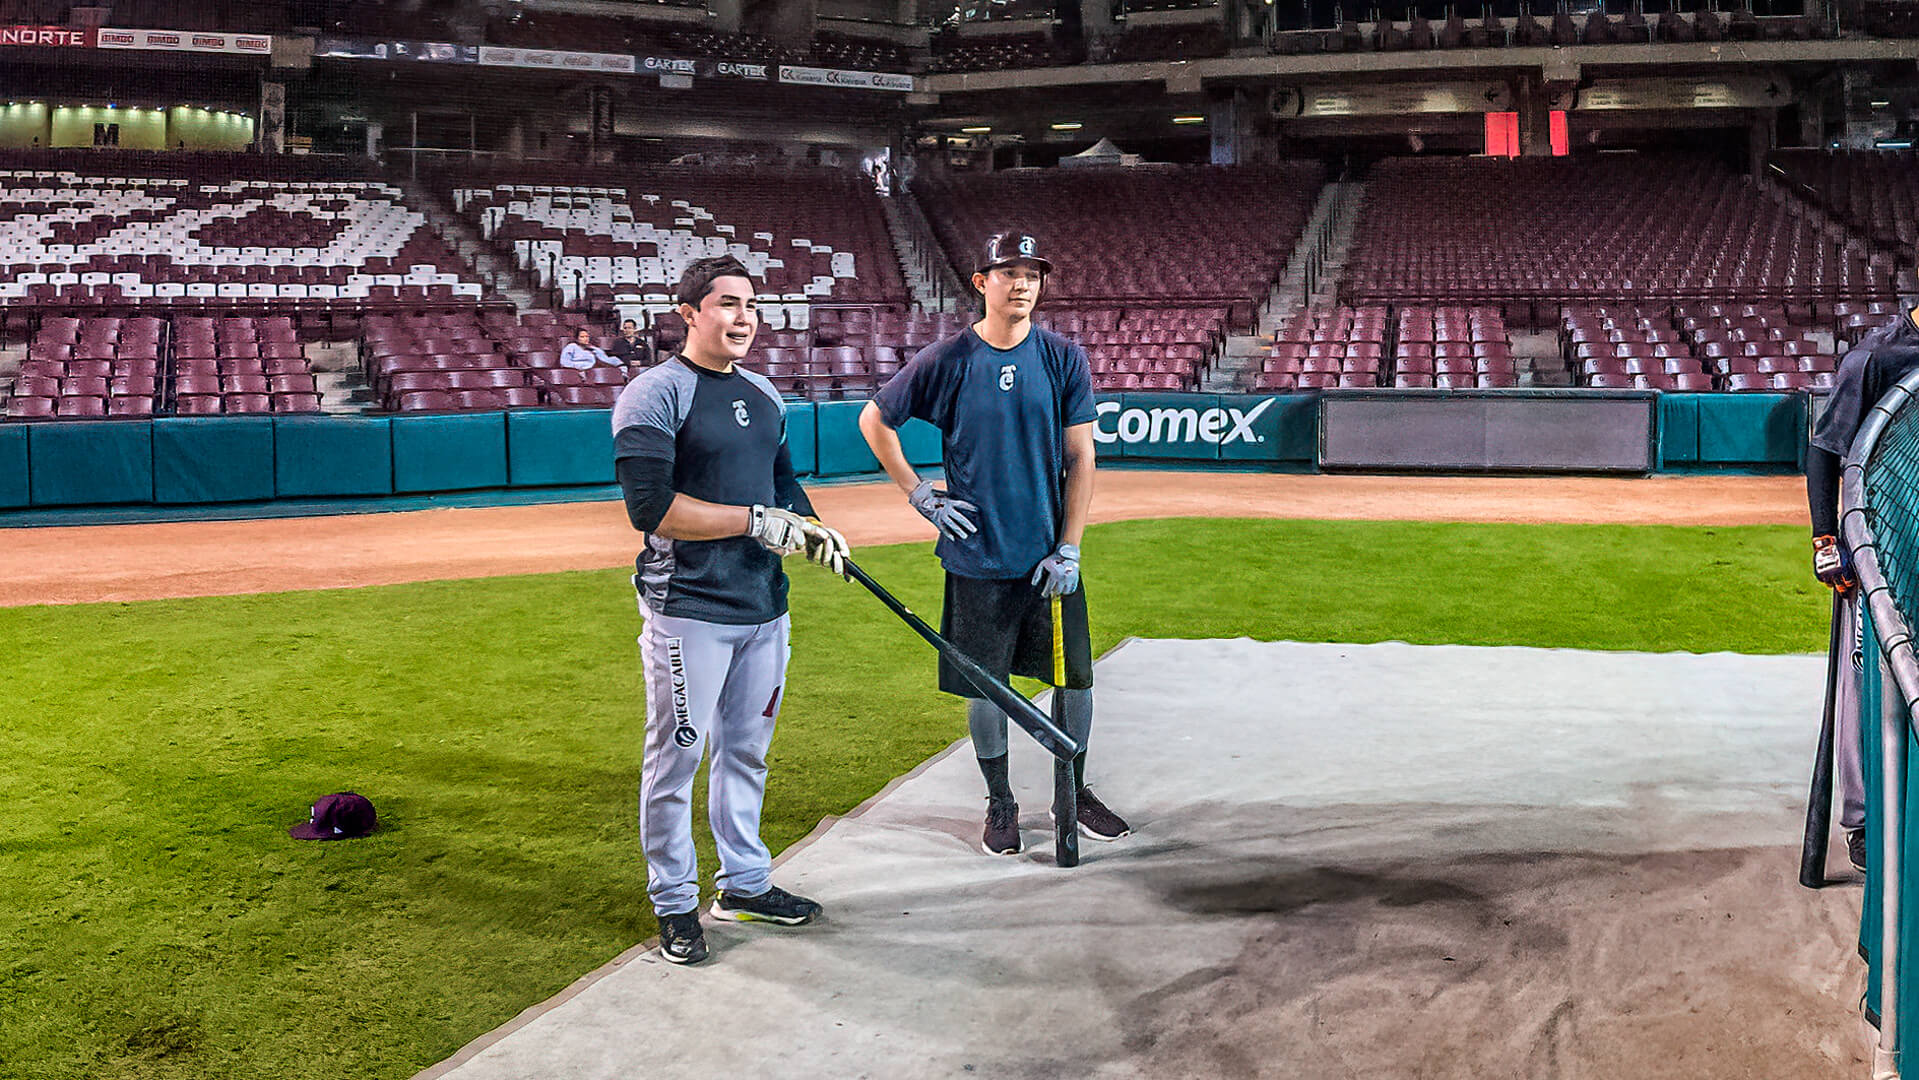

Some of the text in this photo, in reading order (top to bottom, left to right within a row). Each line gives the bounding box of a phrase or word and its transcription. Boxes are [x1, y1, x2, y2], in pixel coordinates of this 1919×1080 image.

[2, 29, 84, 46] NORTE
[644, 57, 696, 73] CARTEK
[717, 62, 768, 77] CARTEK
[94, 123, 119, 146] M
